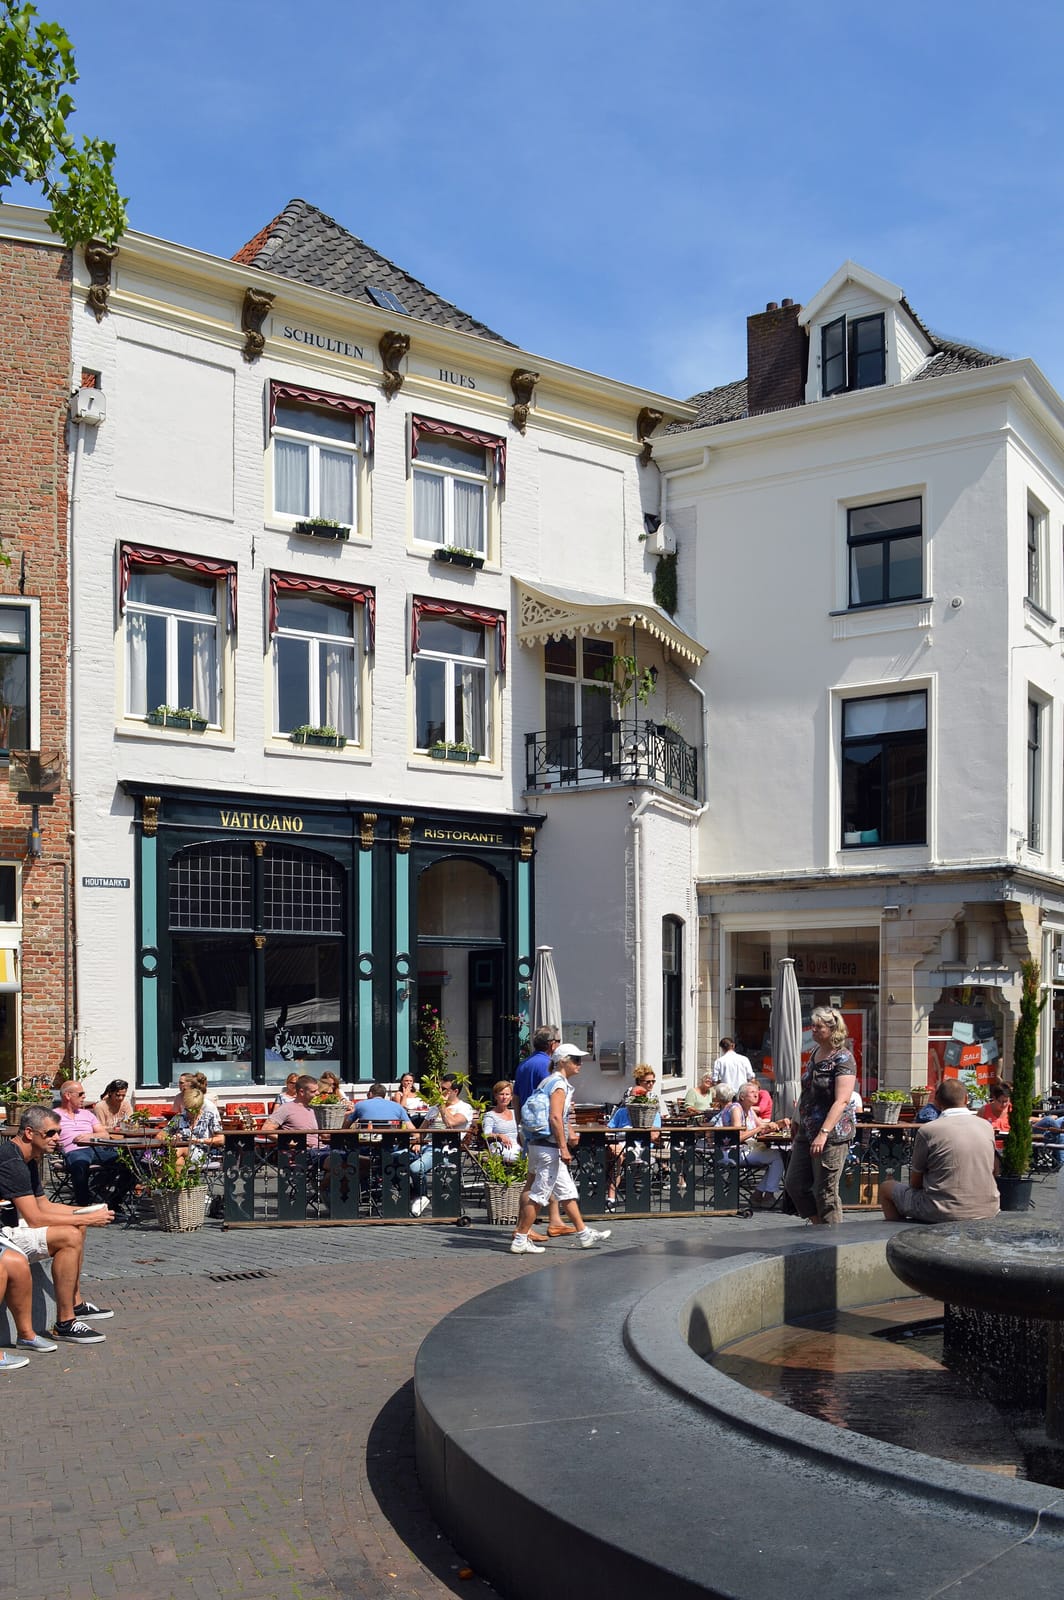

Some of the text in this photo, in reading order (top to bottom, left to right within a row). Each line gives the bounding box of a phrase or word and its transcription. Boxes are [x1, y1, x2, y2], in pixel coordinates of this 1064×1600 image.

[284, 326, 476, 389] SCHULTEN HUES
[220, 810, 303, 832] VATICANO
[424, 828, 503, 844] RISTORANTE
[85, 878, 128, 887] HOUTMARKT
[830, 957, 857, 976] livera
[199, 1035, 246, 1047] VATICANO
[289, 1035, 334, 1047] VATICANO
[963, 1053, 980, 1062] SALE
[977, 1071, 996, 1080] SALE
